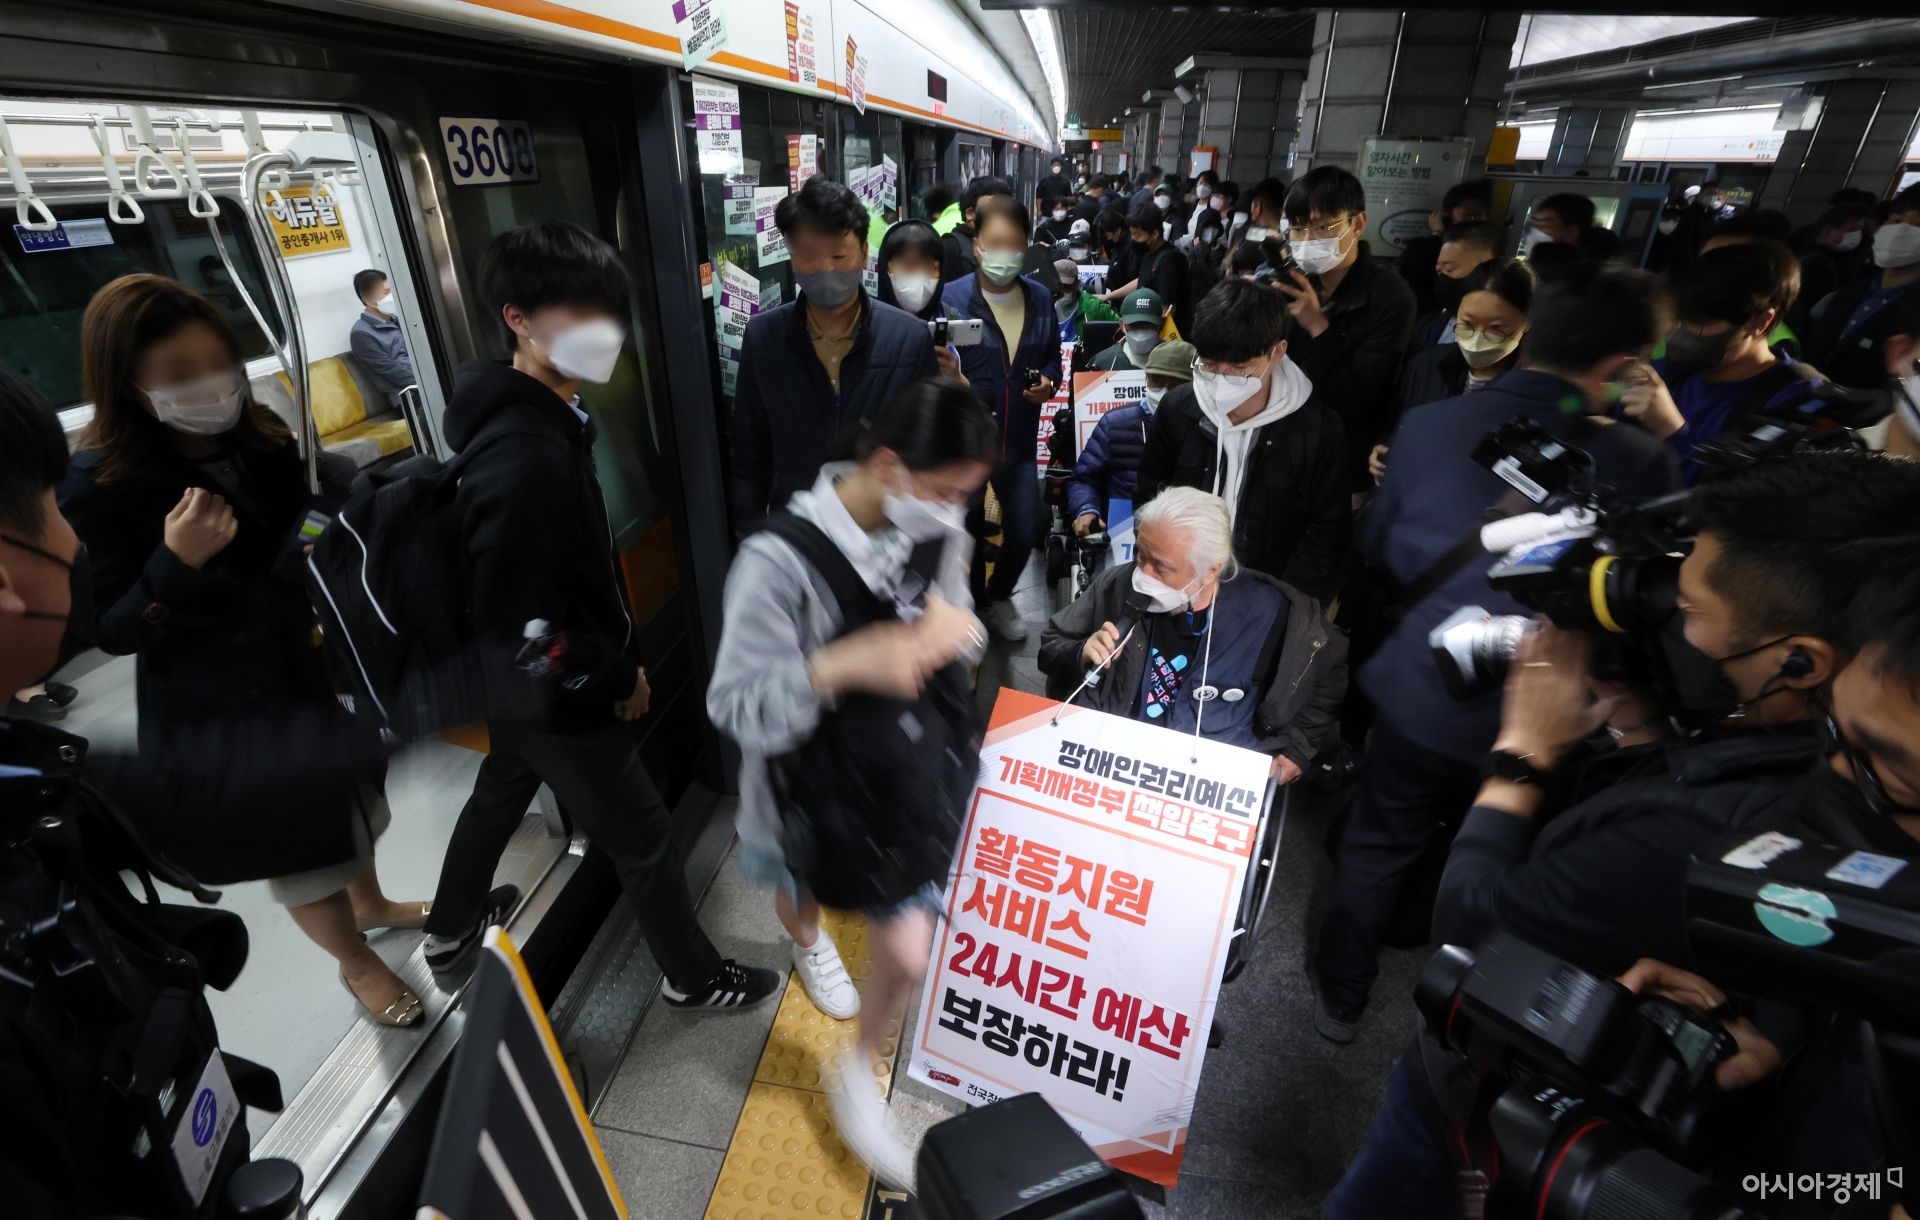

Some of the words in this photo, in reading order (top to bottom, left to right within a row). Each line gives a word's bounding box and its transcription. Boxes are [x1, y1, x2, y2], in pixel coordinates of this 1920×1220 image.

[447, 125, 534, 178] 3608
[1367, 165, 1408, 178] 알아보는
[1411, 167, 1431, 179] 방법
[1370, 152, 1412, 165] 열차시간
[281, 231, 329, 250] 공인중개사
[330, 229, 345, 241] 1위
[1000, 755, 1126, 815] 기획재정부
[1130, 794, 1253, 854] 책임촉구
[1058, 740, 1257, 818] 장애인권리예산
[974, 827, 1154, 926] 활동지원
[962, 877, 1091, 960] 서비스
[949, 932, 1087, 1021] 24시간
[1092, 987, 1190, 1060] 예산
[939, 987, 1131, 1102] 보장하라!
